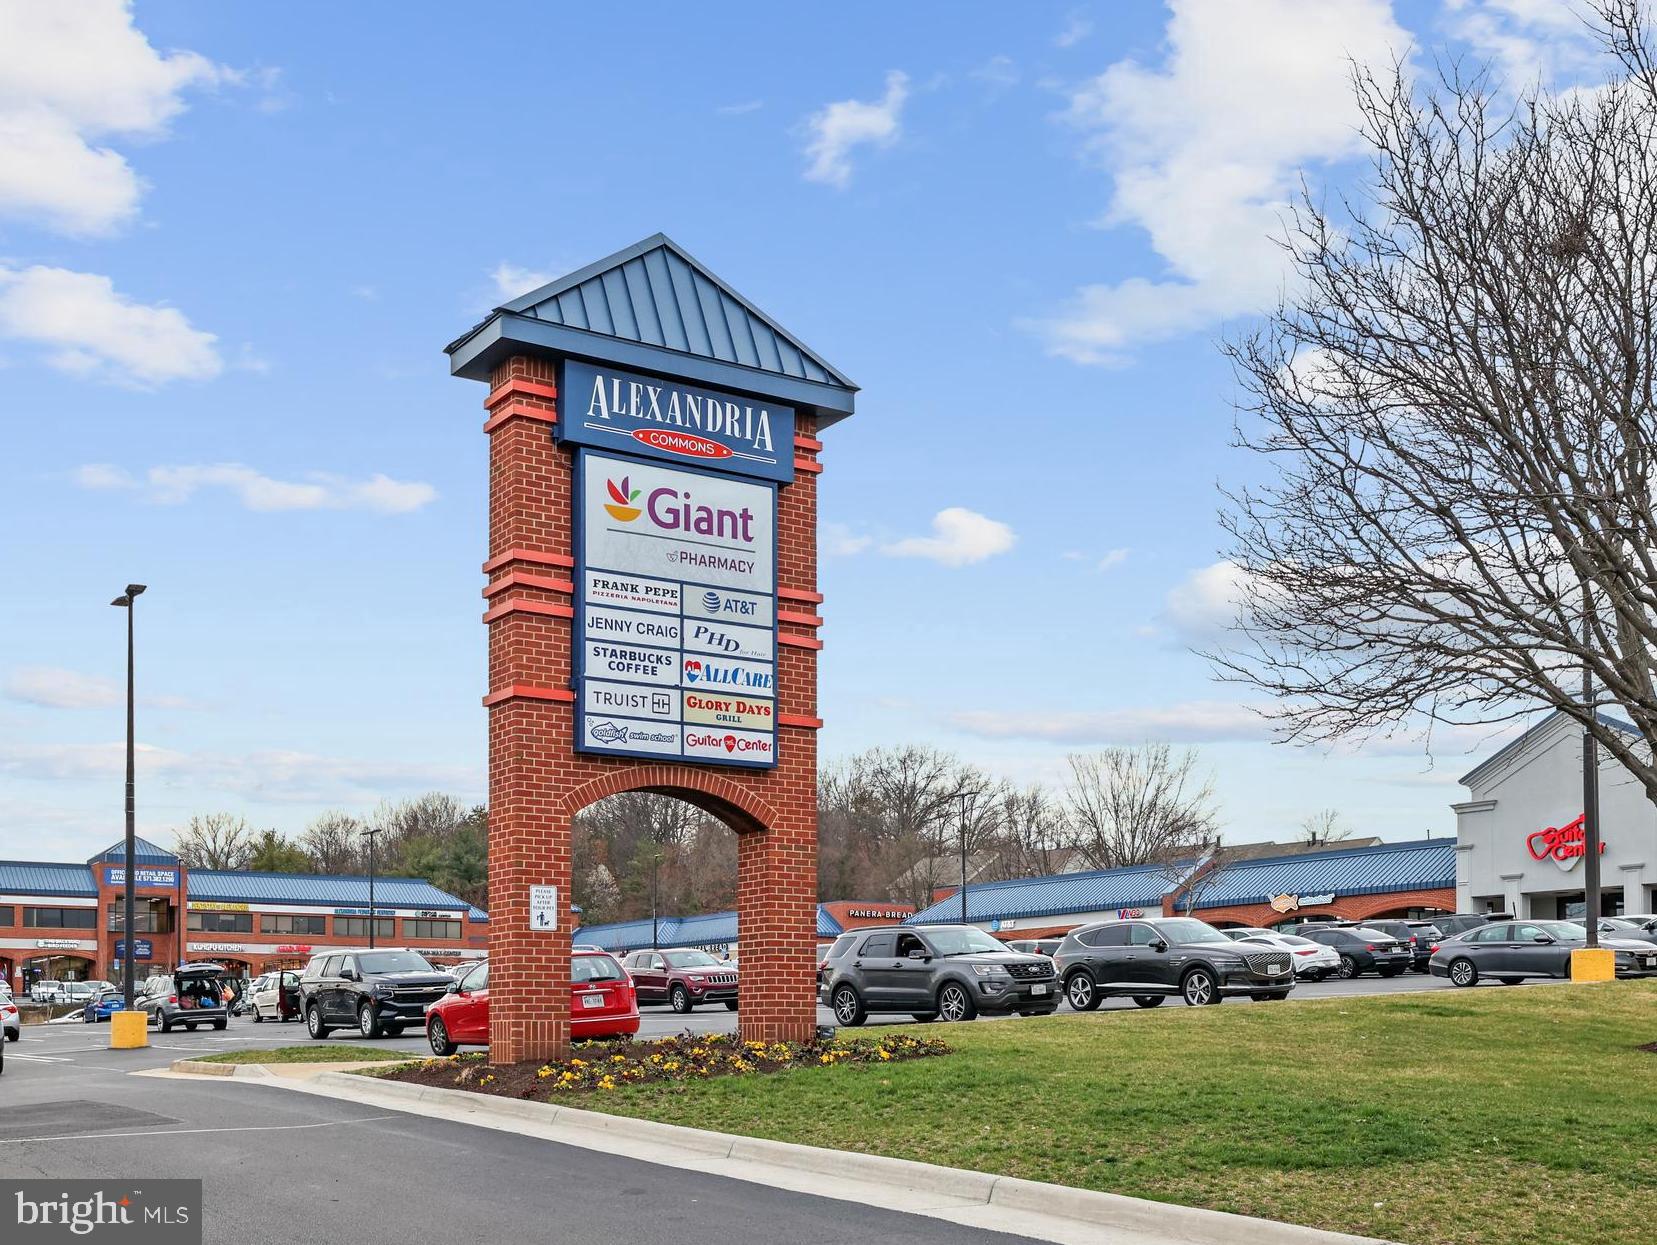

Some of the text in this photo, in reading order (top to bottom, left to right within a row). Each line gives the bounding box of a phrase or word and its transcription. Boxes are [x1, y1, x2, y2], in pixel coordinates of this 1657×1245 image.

[587, 375, 774, 451] ALEXANDRIA
[650, 432, 715, 454] COMMONS
[647, 487, 754, 542] Giant
[680, 551, 755, 574] PHARMACY
[592, 590, 678, 607] PIZZERIA NAPOLETANA
[593, 579, 678, 599] FRANK PEPE
[723, 598, 757, 616] AT&T
[587, 616, 678, 639] JENNY CRAIG
[693, 625, 740, 652] PHD
[593, 646, 672, 666] STARBUCKS
[608, 660, 658, 676] COFFEE
[593, 690, 648, 708] TRUIST
[686, 695, 771, 716] GLORY DAYS
[716, 713, 742, 723] GRILL
[592, 728, 675, 743] goldfish swim school
[686, 733, 772, 752] Guitar Center
[849, 909, 913, 919] PANERA BREAD
[1001, 920, 1015, 928] AT&T
